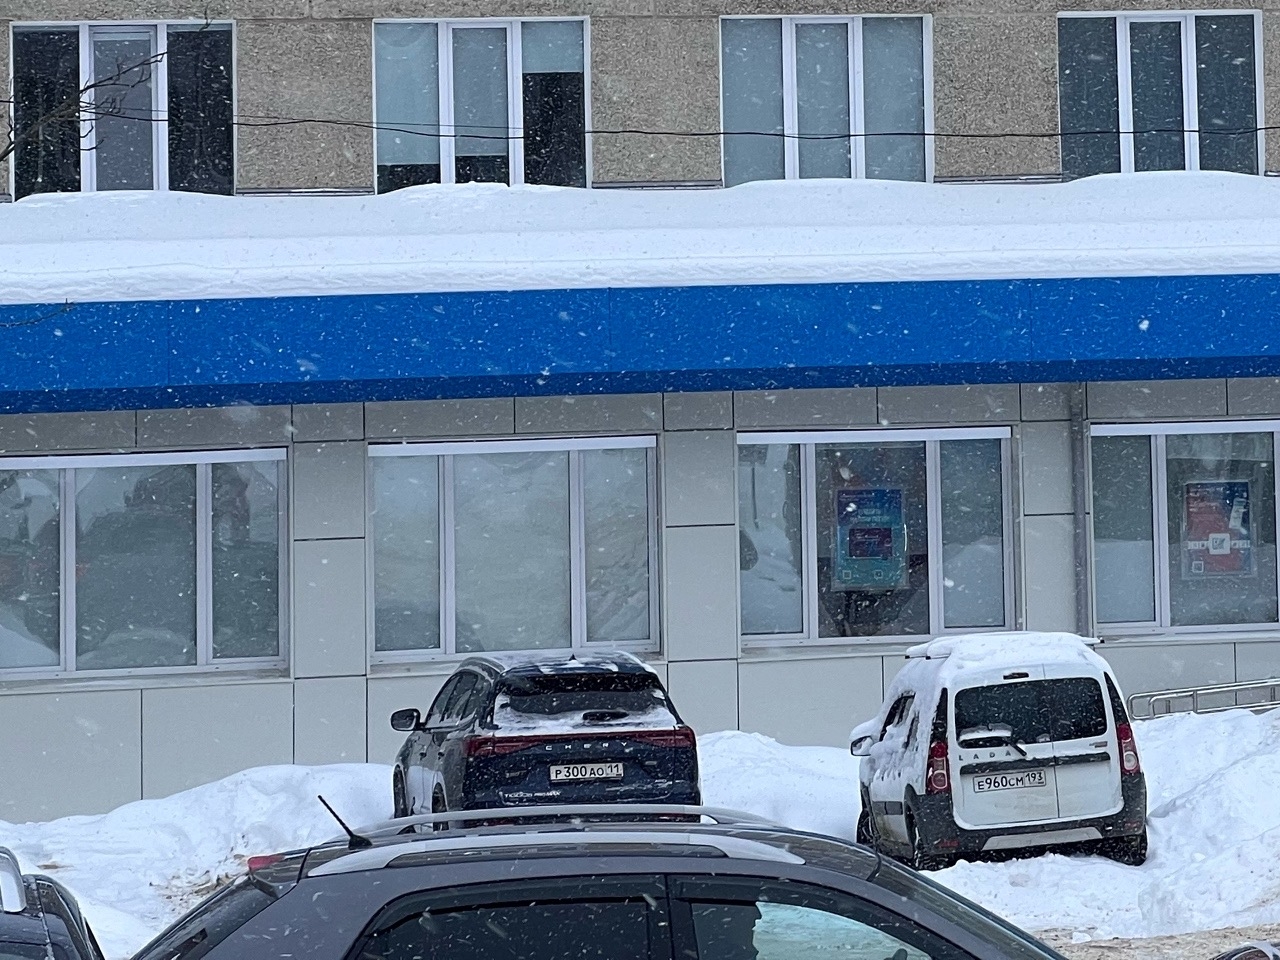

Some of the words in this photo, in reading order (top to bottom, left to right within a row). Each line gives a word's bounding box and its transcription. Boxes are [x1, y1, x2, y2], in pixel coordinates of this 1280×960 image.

[545, 742, 628, 751] CHERY
[958, 750, 1012, 761] LADA
[555, 765, 605, 779] Р300АО
[607, 763, 620, 773] 11
[977, 775, 1024, 790] Е960СМ
[1025, 771, 1044, 782] 193
